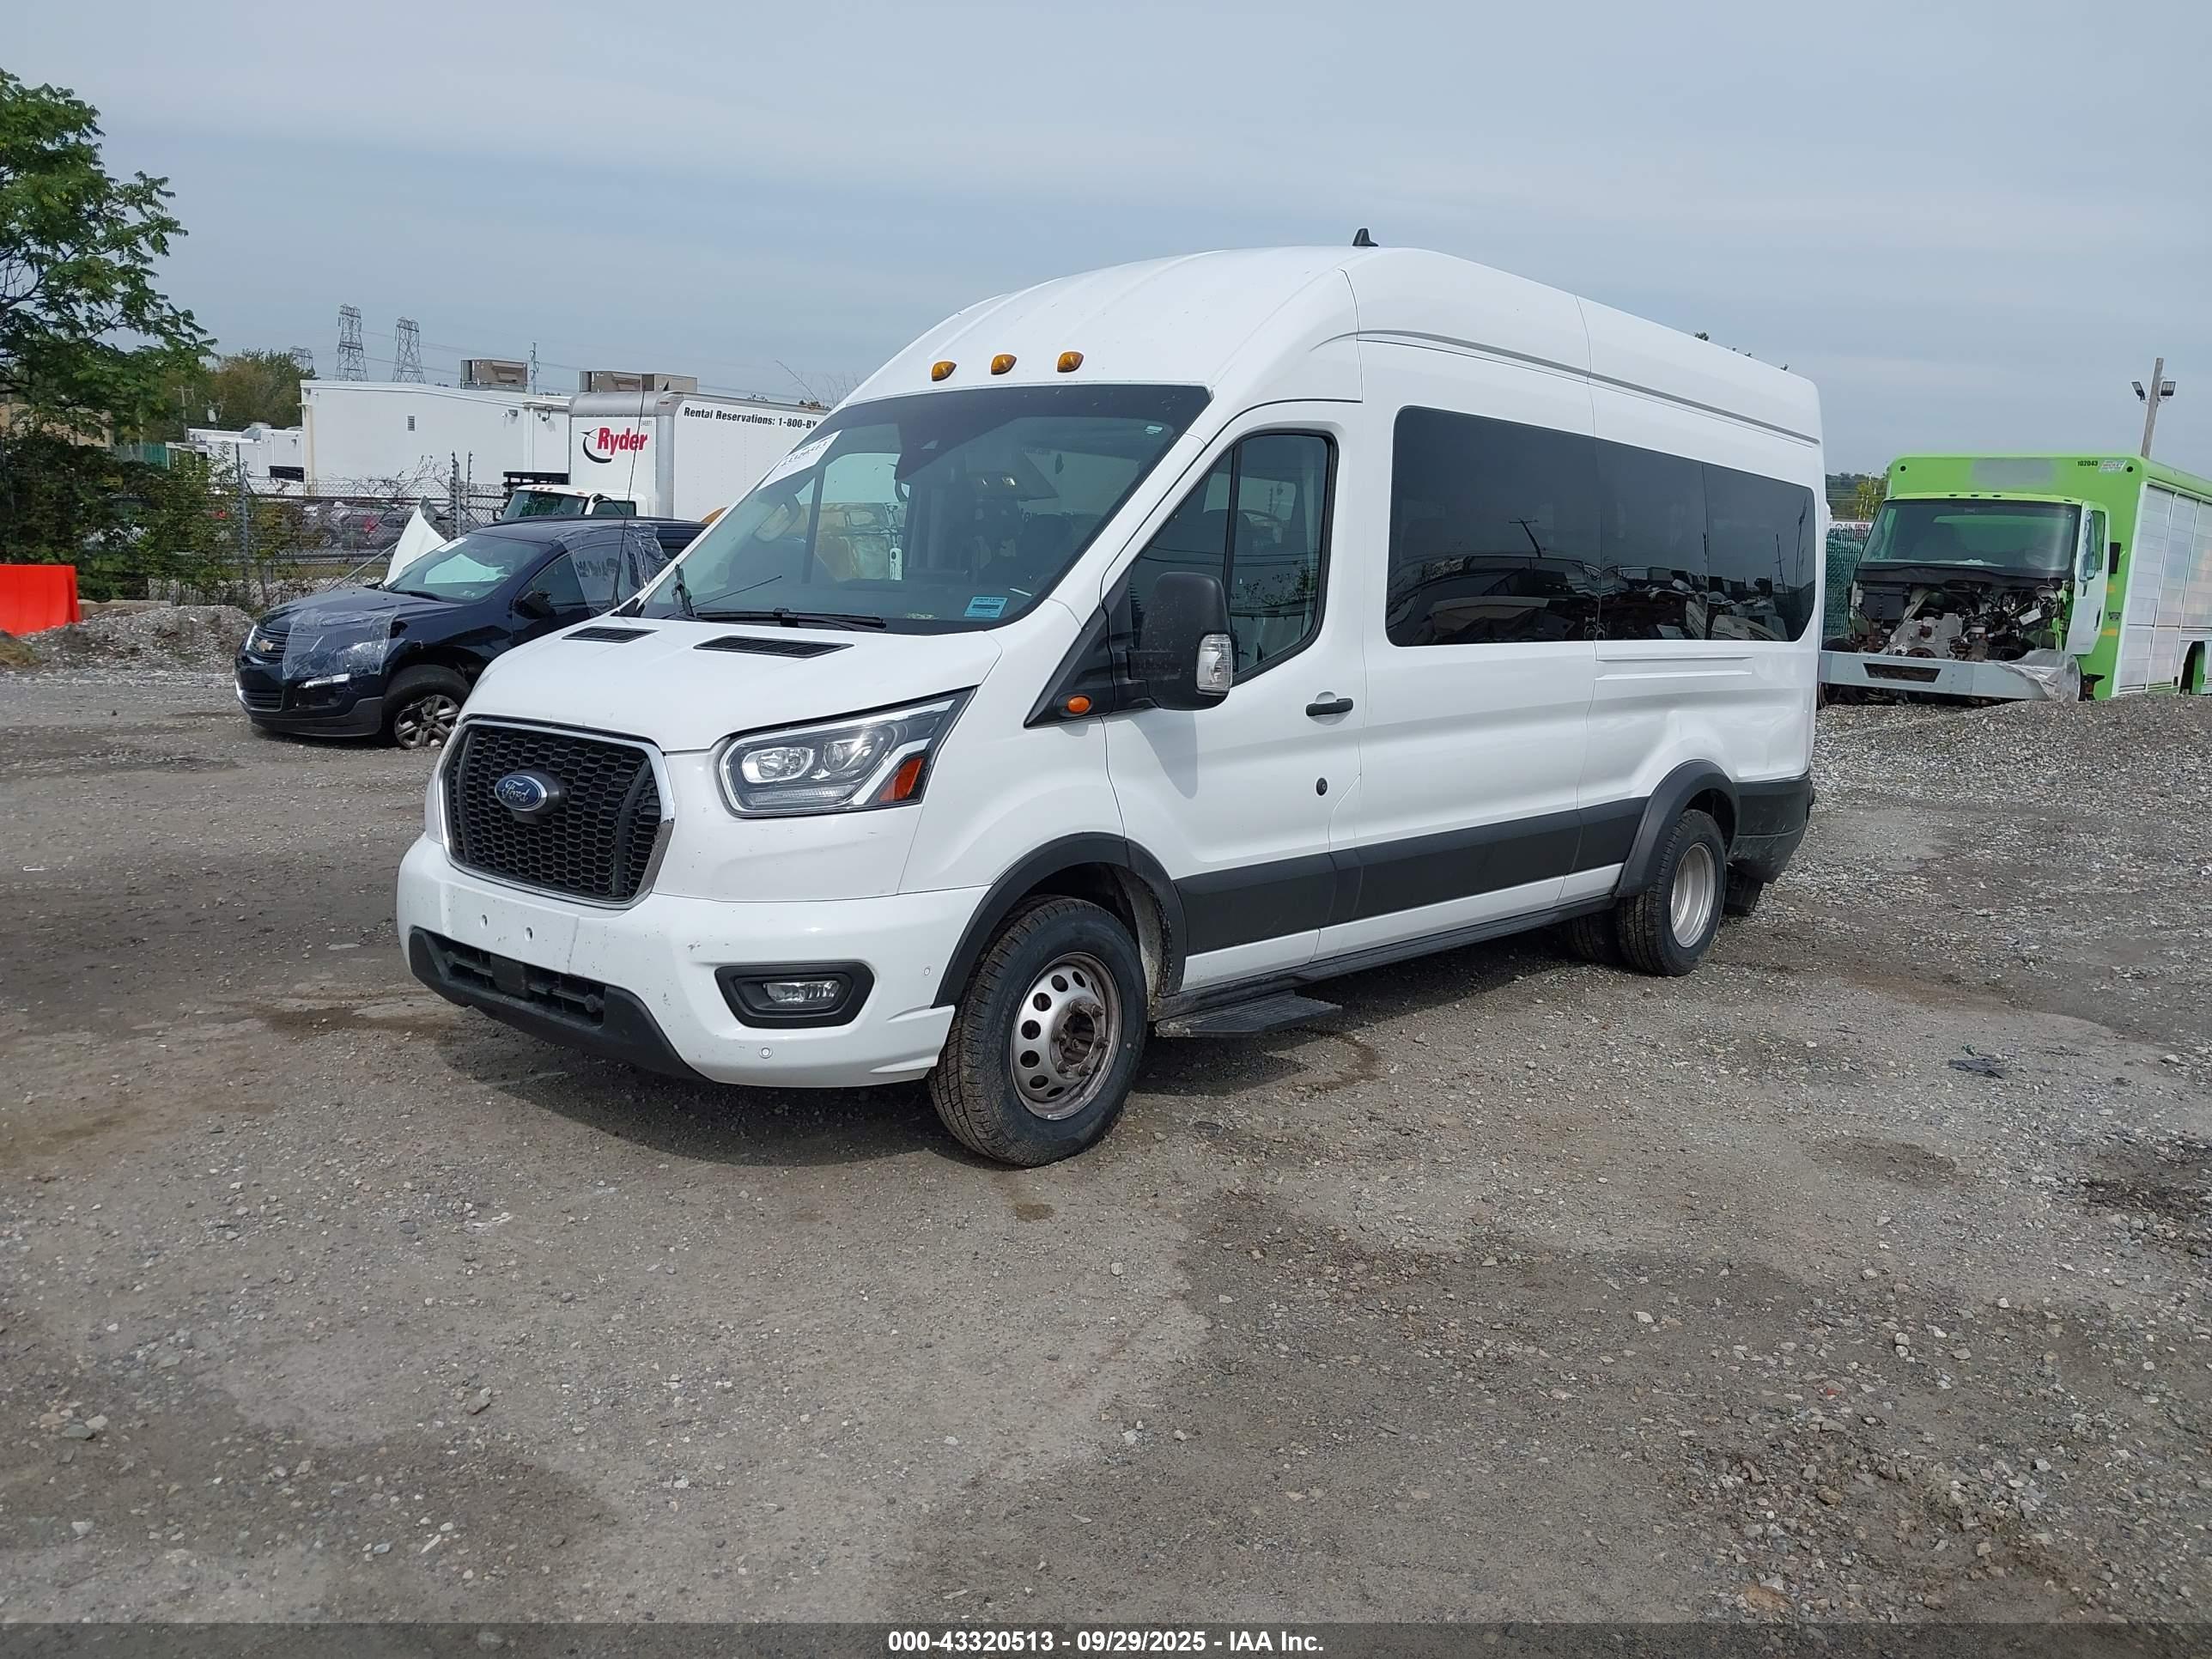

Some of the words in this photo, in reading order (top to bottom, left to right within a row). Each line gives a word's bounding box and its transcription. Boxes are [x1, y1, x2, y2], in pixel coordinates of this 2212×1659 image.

[684, 407, 714, 419] Rental
[716, 410, 775, 426] Reservations:
[597, 427, 648, 456] Ryder
[501, 779, 531, 803] Ford
